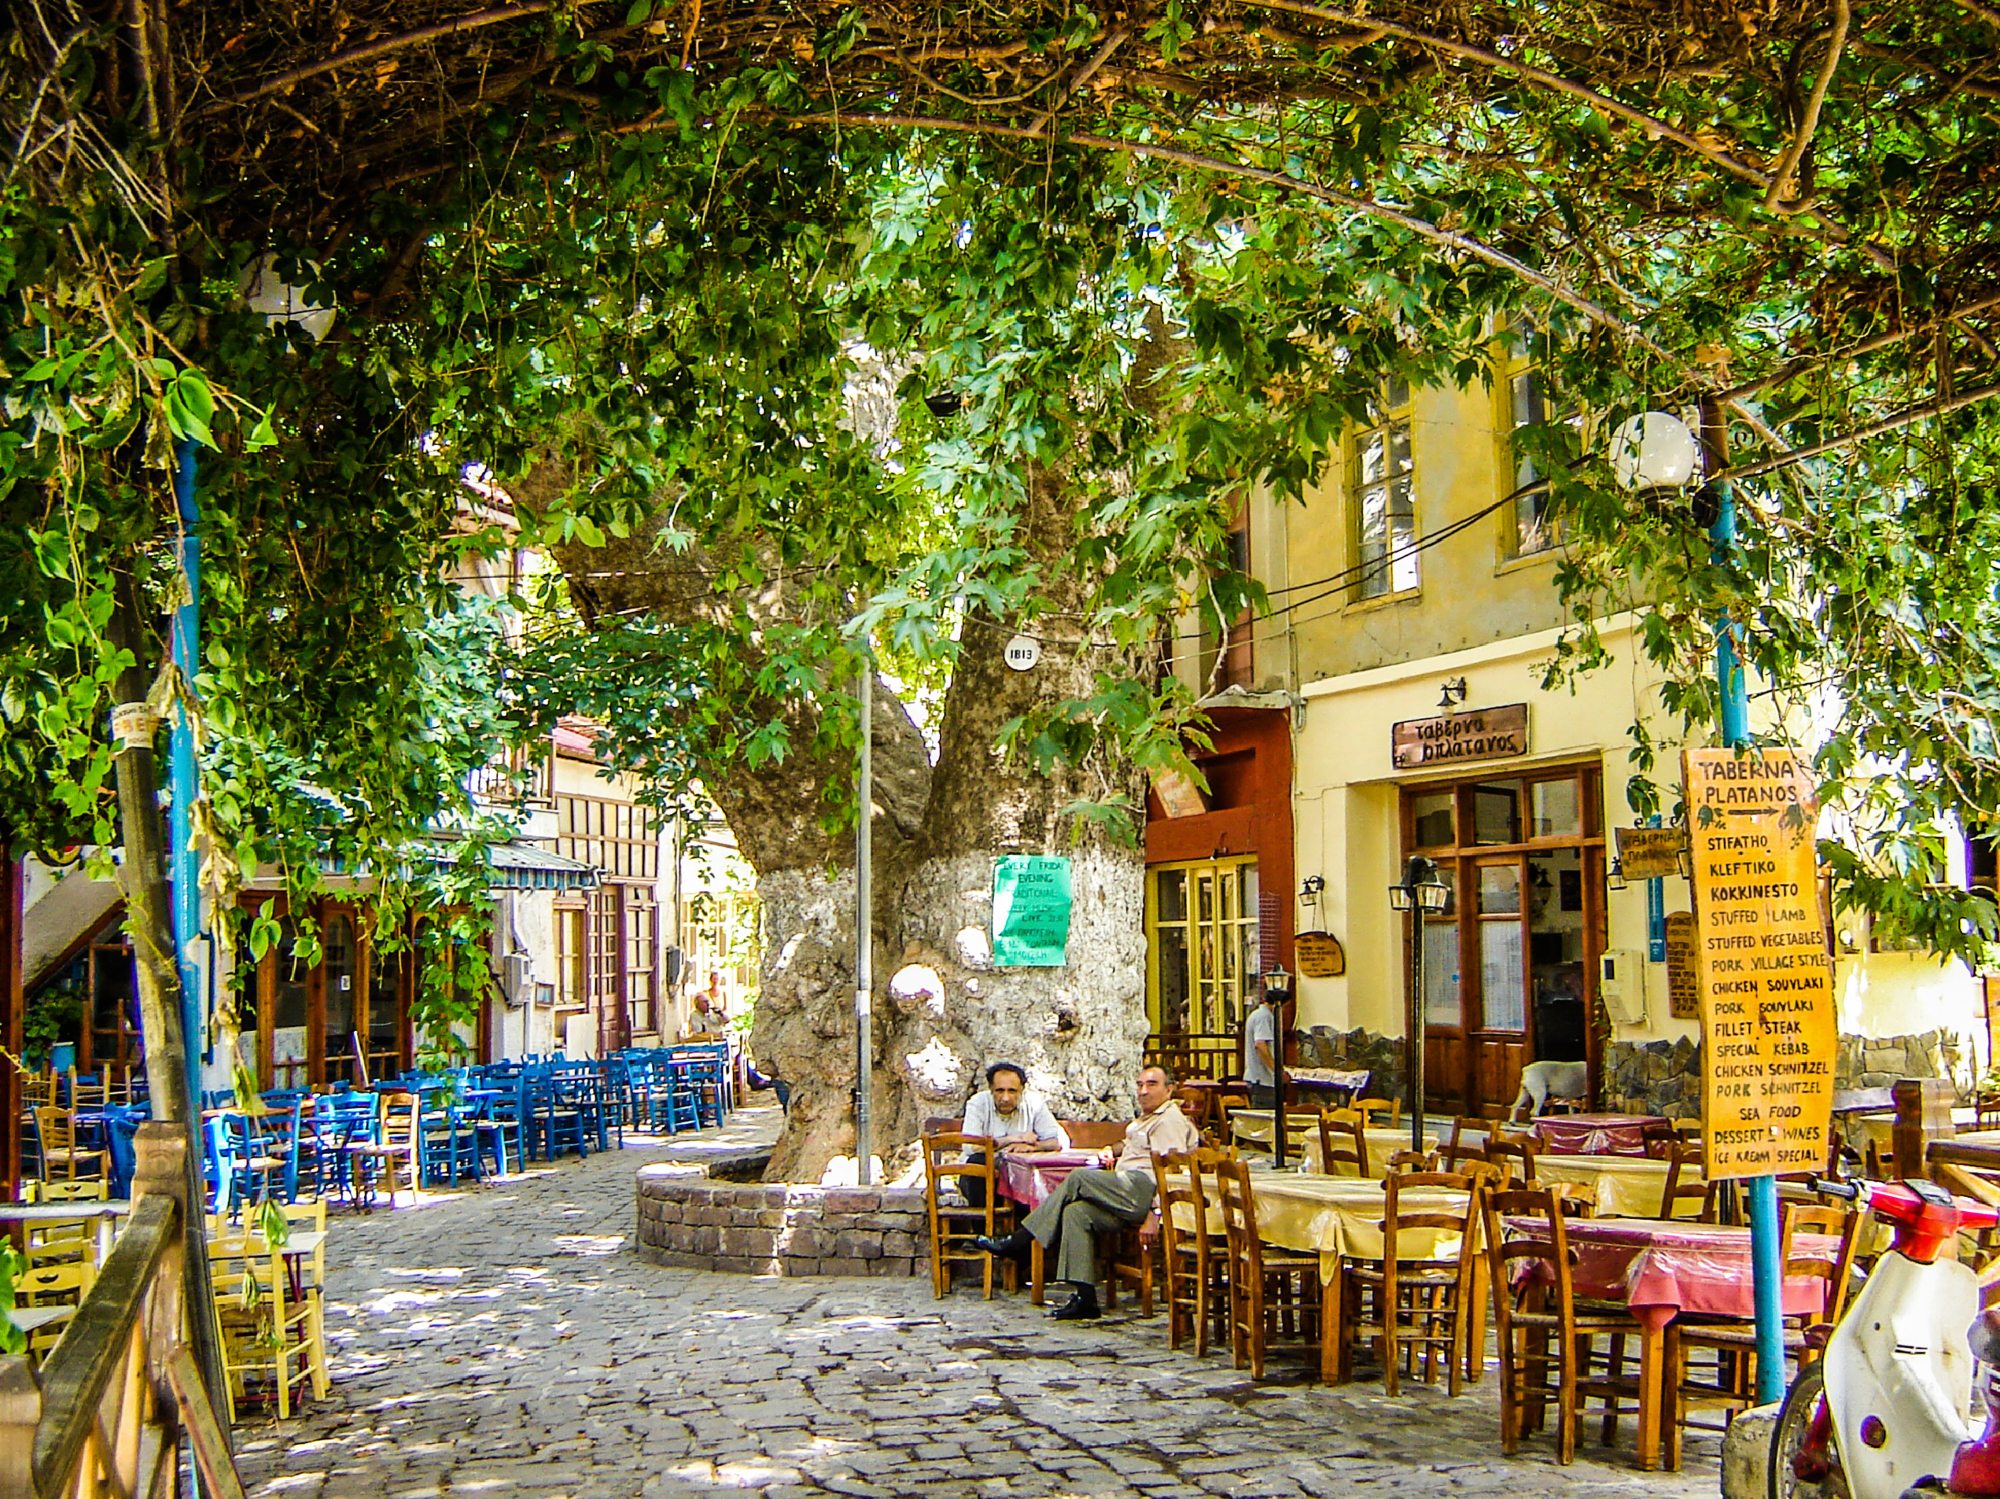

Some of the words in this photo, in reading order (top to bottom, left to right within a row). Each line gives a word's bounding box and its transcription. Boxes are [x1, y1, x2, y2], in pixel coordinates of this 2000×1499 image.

[1010, 649, 1033, 660] 1813
[1698, 760, 1794, 780] TABERNA
[1706, 785, 1798, 803] PLATANOS
[1708, 835, 1768, 850] STIFATHO
[1003, 861, 1031, 871] EVERY
[1710, 861, 1775, 876] KLEFTIKO
[1018, 874, 1054, 884] EVENING
[1711, 883, 1798, 901] KOKKINESTO
[1711, 910, 1758, 926] STUFFED
[1772, 909, 1806, 922] LAMB
[1708, 936, 1756, 950] STUFFED
[1760, 931, 1823, 948] VEGETABLES
[1712, 959, 1744, 973] PORK
[1798, 953, 1828, 967] STYLE
[1712, 981, 1758, 995] CHICKEN
[1767, 977, 1823, 992] SOUVLAKI
[1715, 1002, 1745, 1015] PORK
[1760, 1000, 1813, 1013] SOUVLAKI
[1715, 1022, 1753, 1037] FILLET
[1764, 1020, 1802, 1035] STEAK
[1717, 1044, 1760, 1058] SPECIAL
[1774, 1042, 1810, 1055] KEBAB
[1715, 1065, 1763, 1078] CHICKEN
[1716, 1083, 1751, 1098] PORK
[1760, 1081, 1821, 1096] SCHNITZEL
[1740, 1107, 1760, 1121] SEA
[1769, 1106, 1801, 1118] FOOD
[1714, 1129, 1764, 1144] DESSERT
[1782, 1126, 1820, 1140] WINES
[1777, 1149, 1819, 1162] SPECIAL
